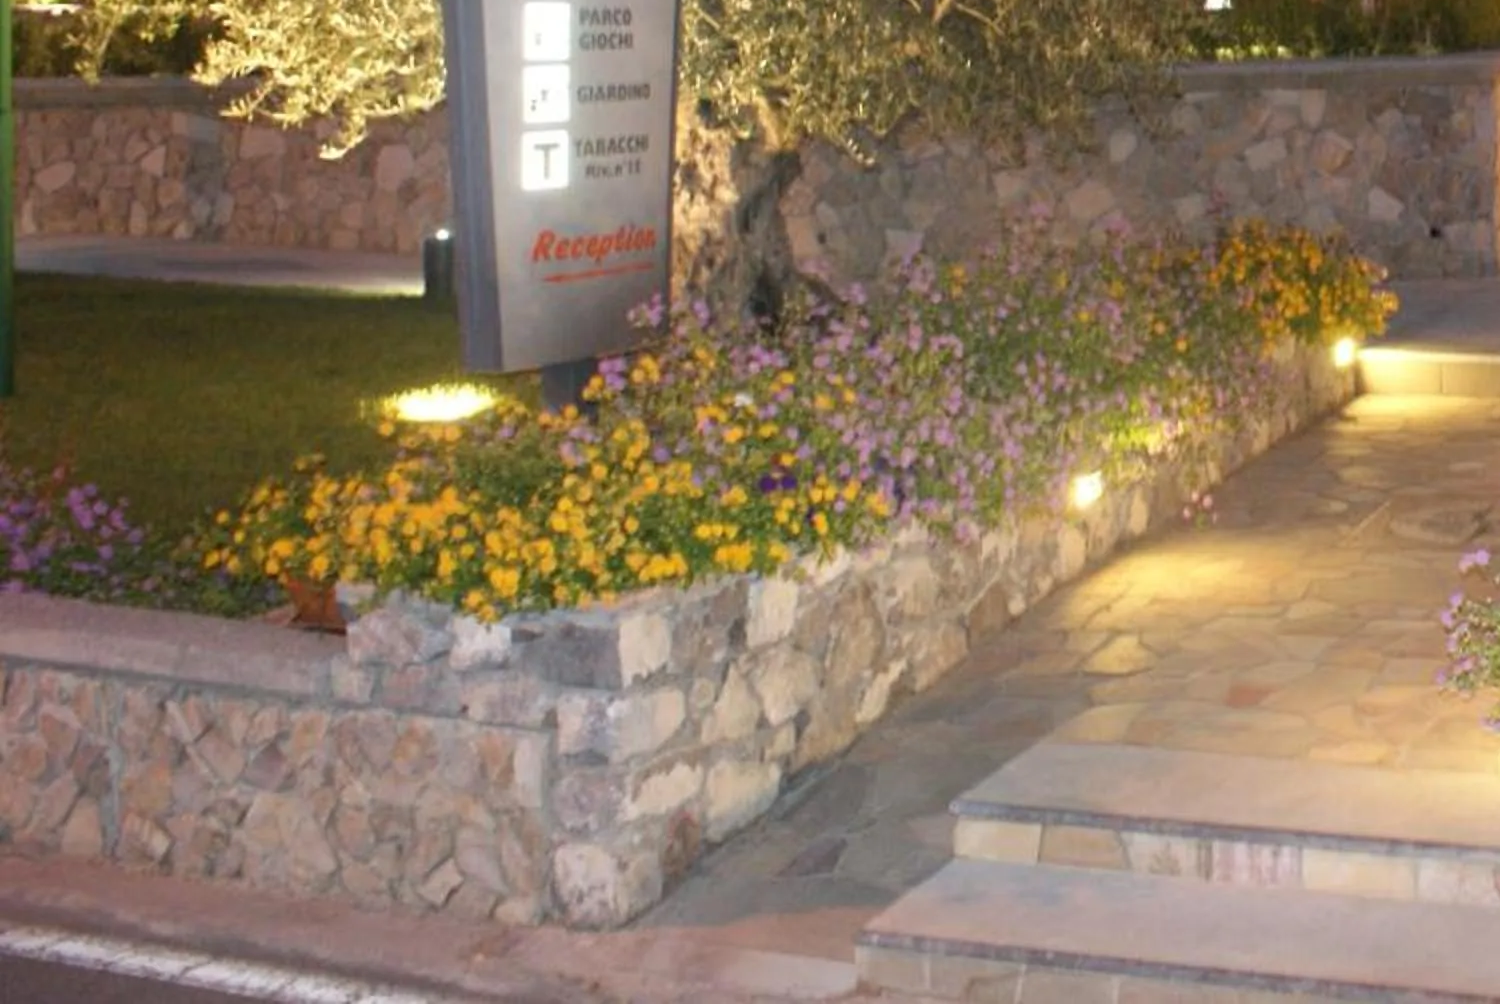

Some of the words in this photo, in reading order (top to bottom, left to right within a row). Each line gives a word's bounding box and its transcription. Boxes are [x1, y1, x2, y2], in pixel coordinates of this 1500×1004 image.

[579, 8, 632, 27] PARCO
[579, 32, 634, 51] GIOCHI
[577, 82, 651, 105] GIARDINO
[573, 134, 649, 158] TABACCHI
[531, 223, 657, 263] Reception
